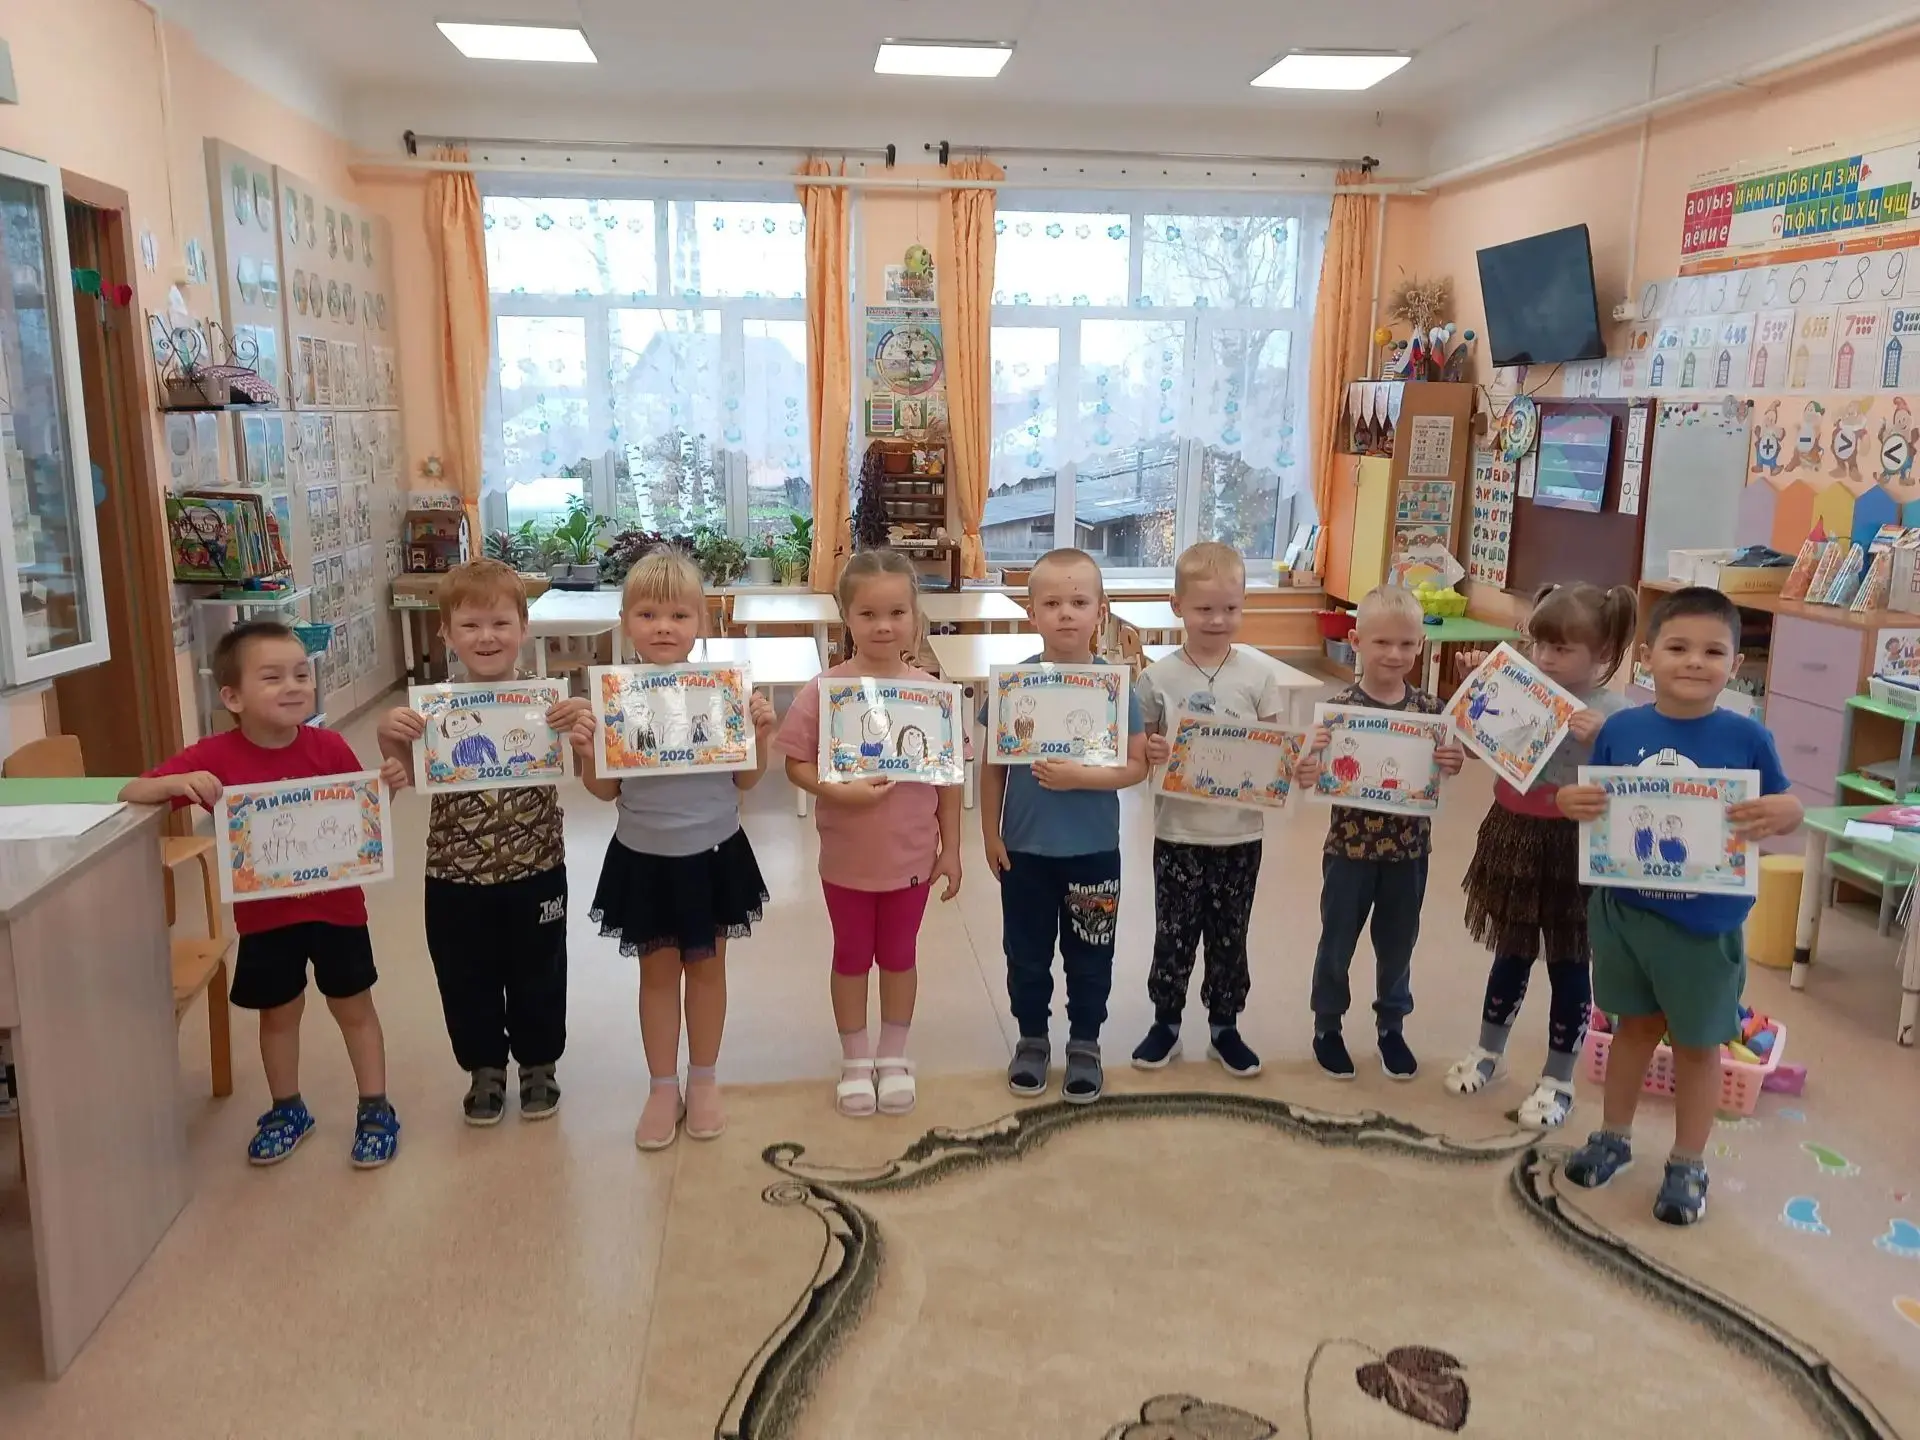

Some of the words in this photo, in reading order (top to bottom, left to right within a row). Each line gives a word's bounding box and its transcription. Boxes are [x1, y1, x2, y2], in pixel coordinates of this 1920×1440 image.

[1788, 264, 1808, 304] 6
[1820, 260, 1839, 301] 7
[1846, 256, 1871, 299] 8
[1880, 251, 1904, 297] 9
[1846, 314, 1858, 337] 7
[1893, 310, 1904, 333] 8
[641, 679, 650, 689] И
[651, 673, 678, 688] МОЙ
[680, 676, 716, 688] ПАПА
[1022, 677, 1031, 688] Я
[1031, 676, 1039, 685] И
[1040, 671, 1062, 683] МОЙ
[1063, 674, 1094, 687] ПАПА
[1502, 665, 1511, 675] Я
[1509, 668, 1517, 678] И
[1514, 671, 1533, 687] МОЙ
[1529, 683, 1552, 708] ПАПА
[450, 698, 459, 709] Я
[461, 697, 469, 706] И
[470, 690, 495, 704] МОЙ
[496, 693, 531, 704] ПАПА
[856, 691, 865, 701] Я
[899, 690, 929, 704] ПАПА
[1348, 719, 1356, 729] Я
[1358, 720, 1365, 729] И
[1366, 718, 1389, 729] МОЙ
[1200, 727, 1210, 736] Я
[1212, 728, 1220, 737] И
[1221, 727, 1247, 738] МОЙ
[1476, 730, 1499, 751] 2026
[660, 749, 695, 761] 2026
[1040, 742, 1071, 753] 2026
[478, 766, 512, 778] 2026
[878, 759, 910, 769] 2026
[1208, 786, 1239, 798] 2026
[1360, 787, 1391, 801] 2026
[1617, 784, 1627, 795] Я
[1628, 783, 1638, 794] И
[1640, 779, 1670, 794] МОЙ
[1673, 781, 1719, 799] ПАПА
[255, 797, 267, 811] Я
[270, 796, 279, 807] И
[281, 788, 311, 805] МОЙ
[313, 788, 356, 801] ПАПА
[292, 865, 329, 881] 2026
[1643, 862, 1682, 878] 2026
